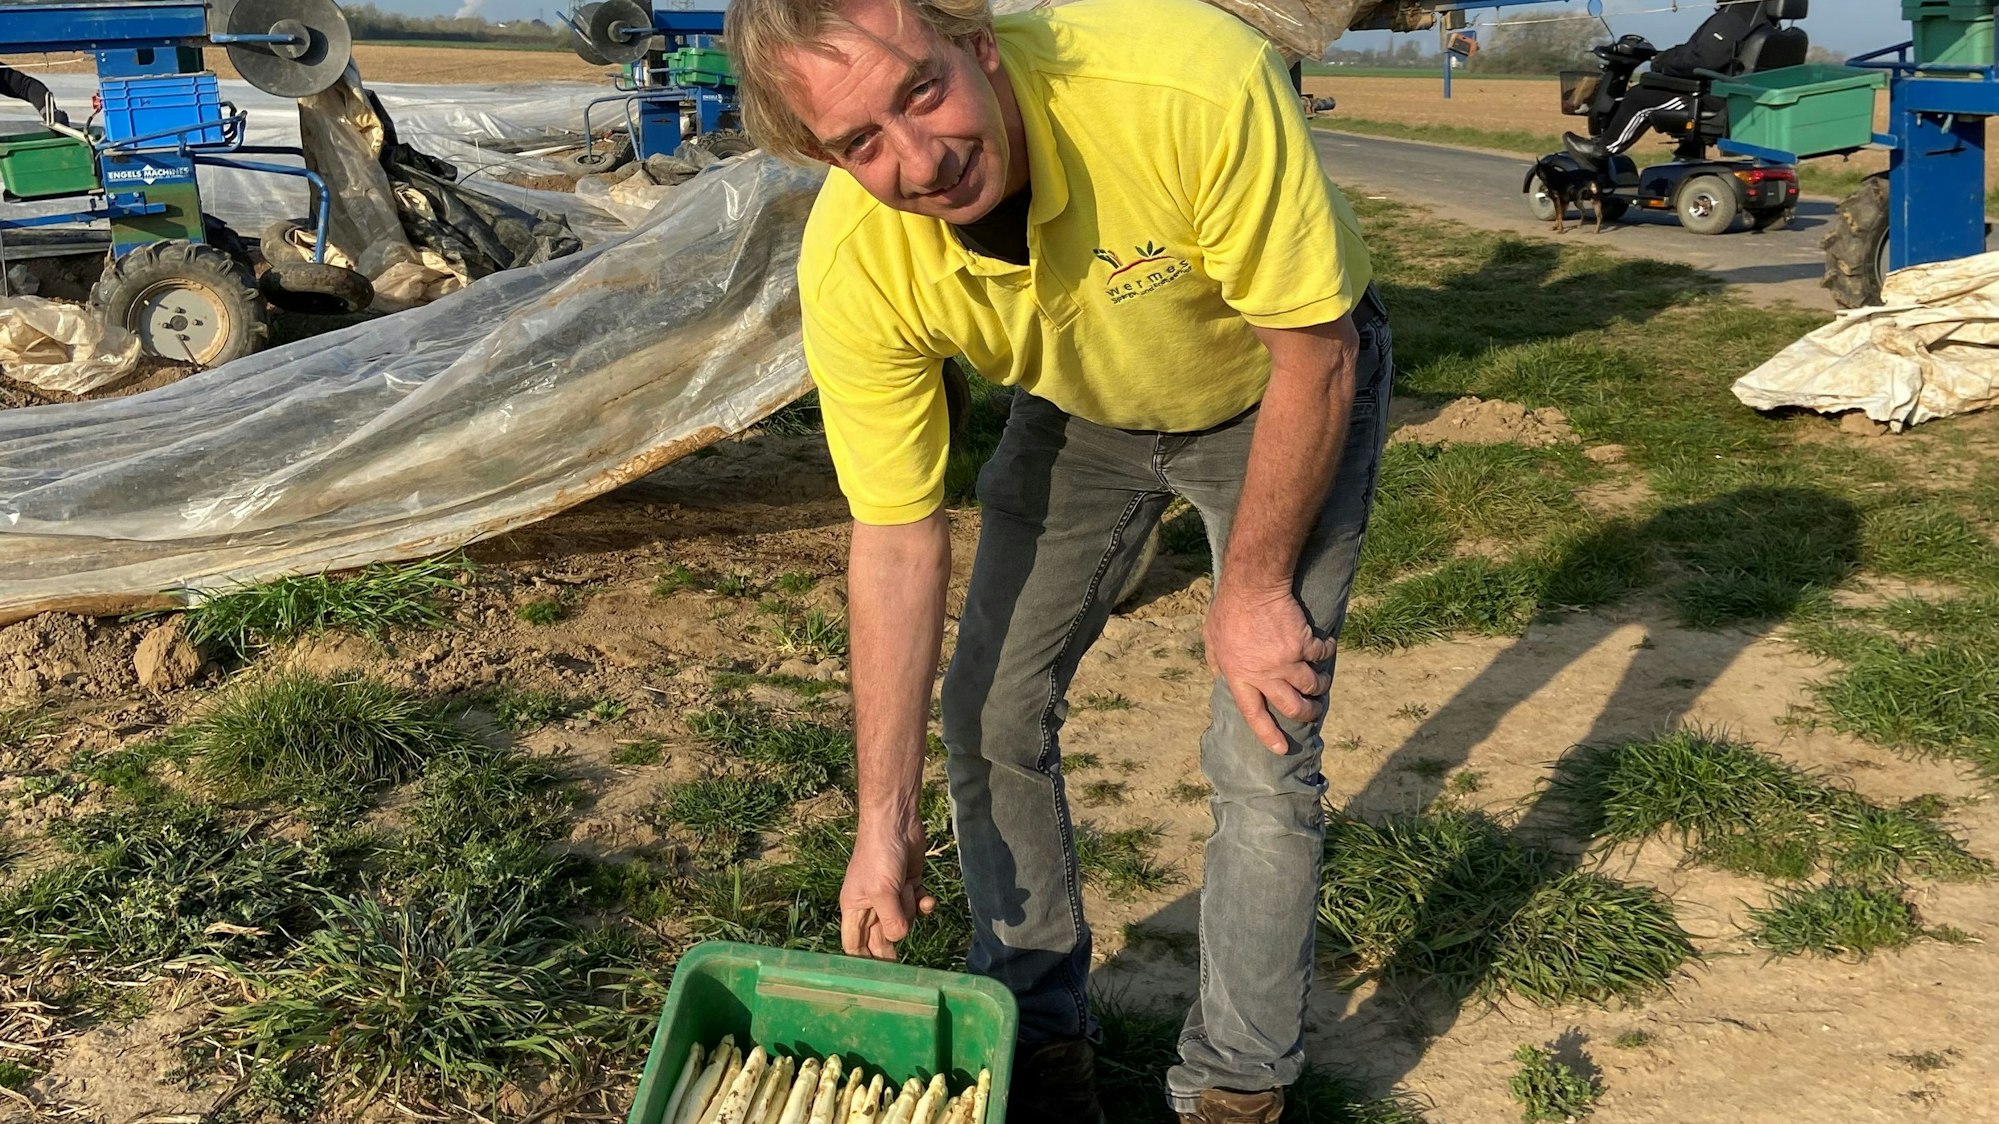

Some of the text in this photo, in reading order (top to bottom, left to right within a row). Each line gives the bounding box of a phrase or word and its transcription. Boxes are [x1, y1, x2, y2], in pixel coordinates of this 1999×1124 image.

[107, 171, 142, 179] ENGELS
[144, 167, 189, 177] MACHINES
[1106, 259, 1189, 297] wermes
